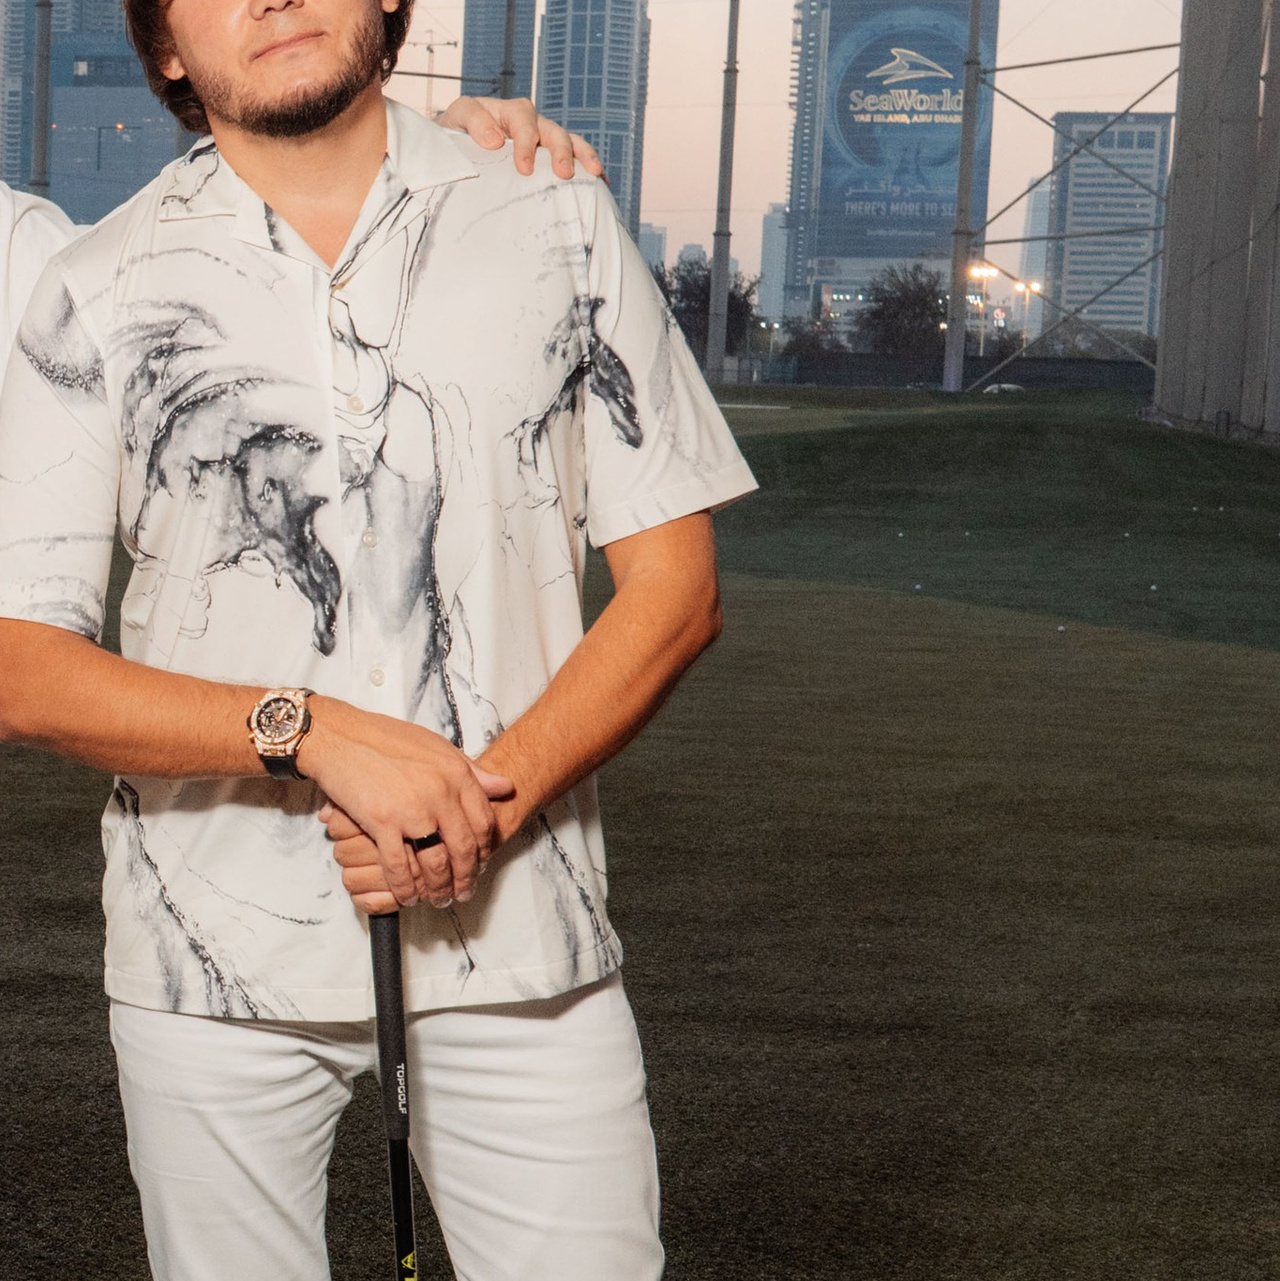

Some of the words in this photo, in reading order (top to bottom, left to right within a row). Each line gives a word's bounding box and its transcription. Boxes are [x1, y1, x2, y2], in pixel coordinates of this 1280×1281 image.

[849, 88, 964, 111] SeaWorld
[845, 201, 887, 216] THERE'S
[890, 201, 921, 216] MORE
[924, 202, 938, 216] TO
[941, 202, 957, 216] SE
[396, 1062, 408, 1114] TOPGOLF
